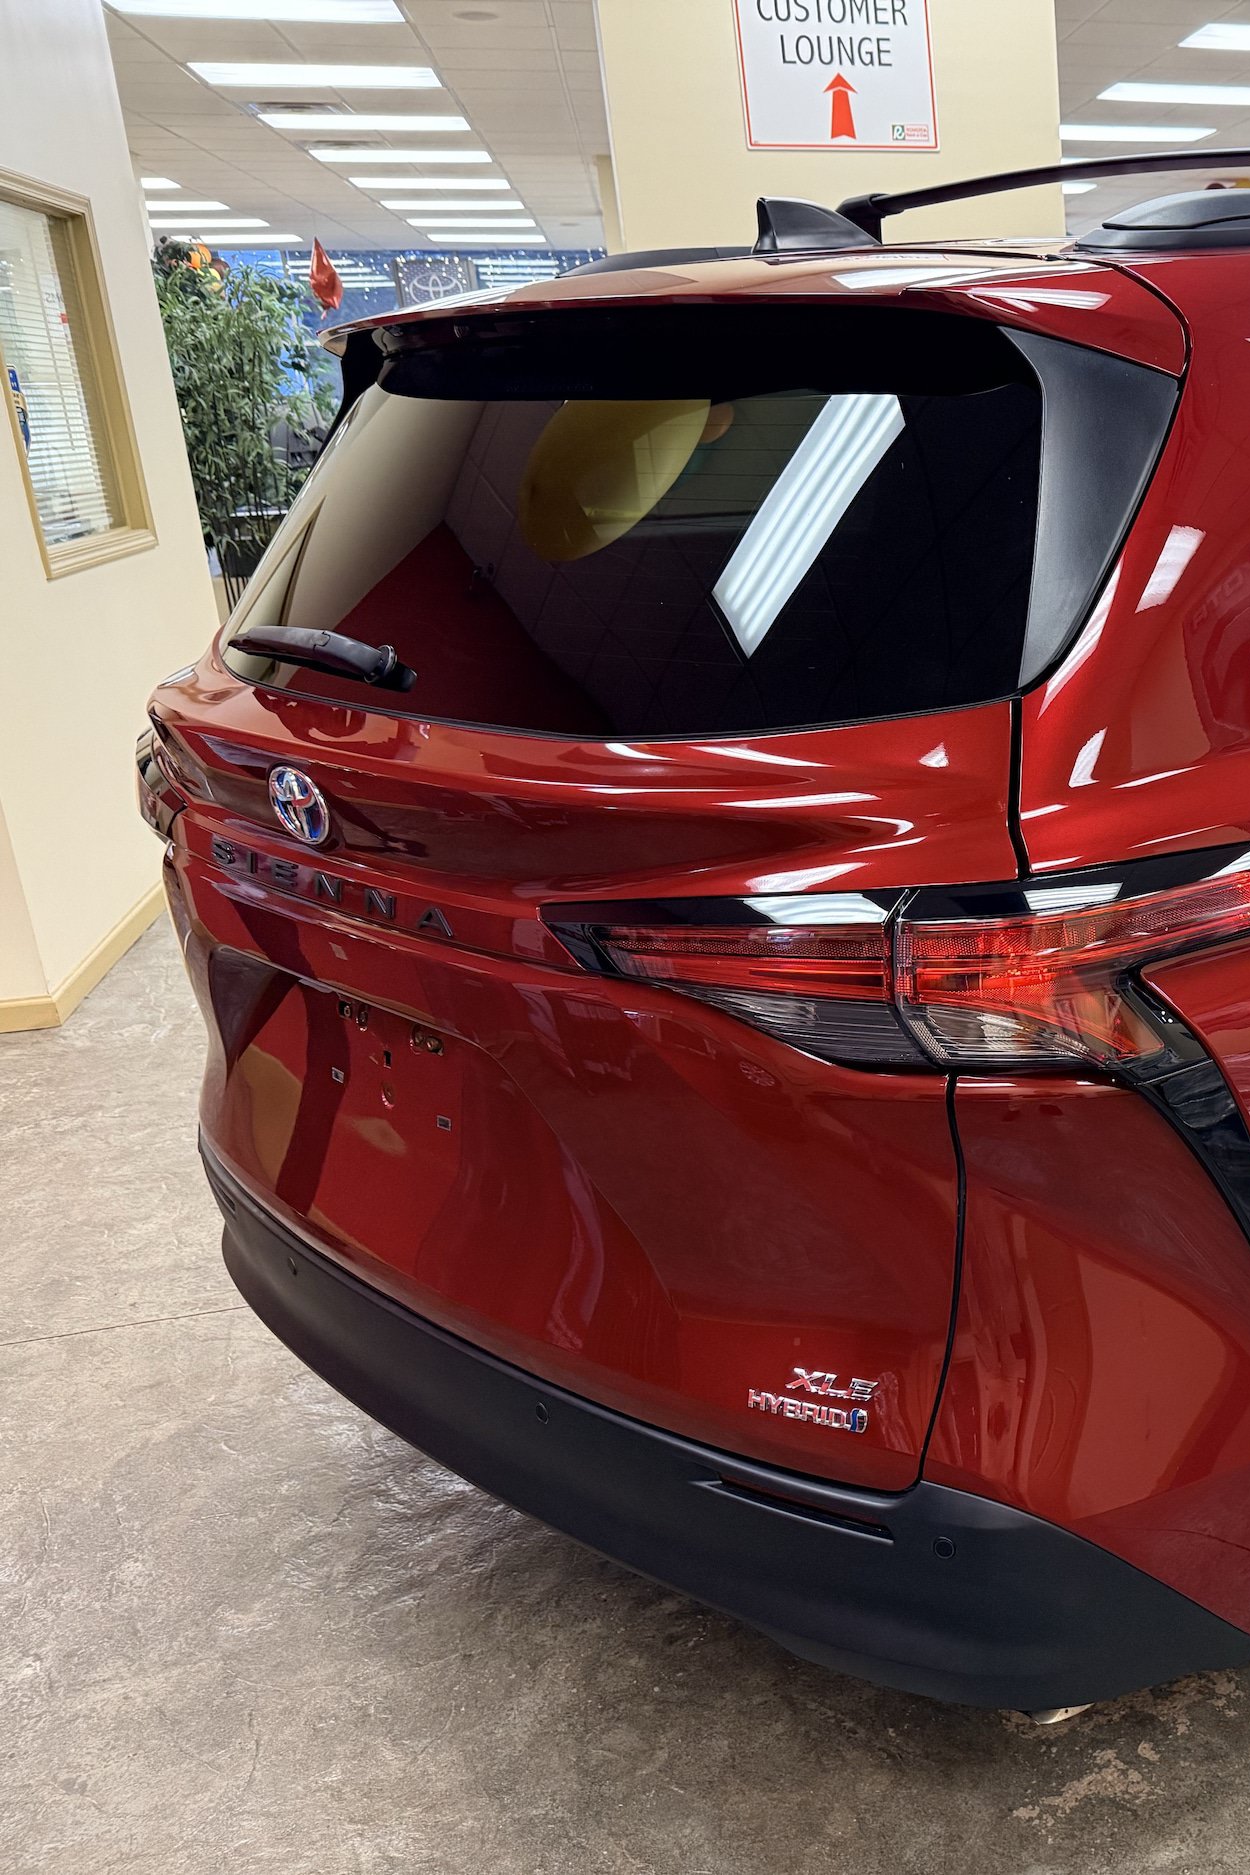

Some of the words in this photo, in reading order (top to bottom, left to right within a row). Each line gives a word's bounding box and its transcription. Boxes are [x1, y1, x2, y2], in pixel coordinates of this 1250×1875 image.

[757, 0, 908, 26] CUSTOMER
[780, 34, 893, 67] LOUNGE
[211, 835, 456, 938] SIENNA
[785, 1367, 879, 1402] XLE
[747, 1388, 852, 1431] HYBRID
